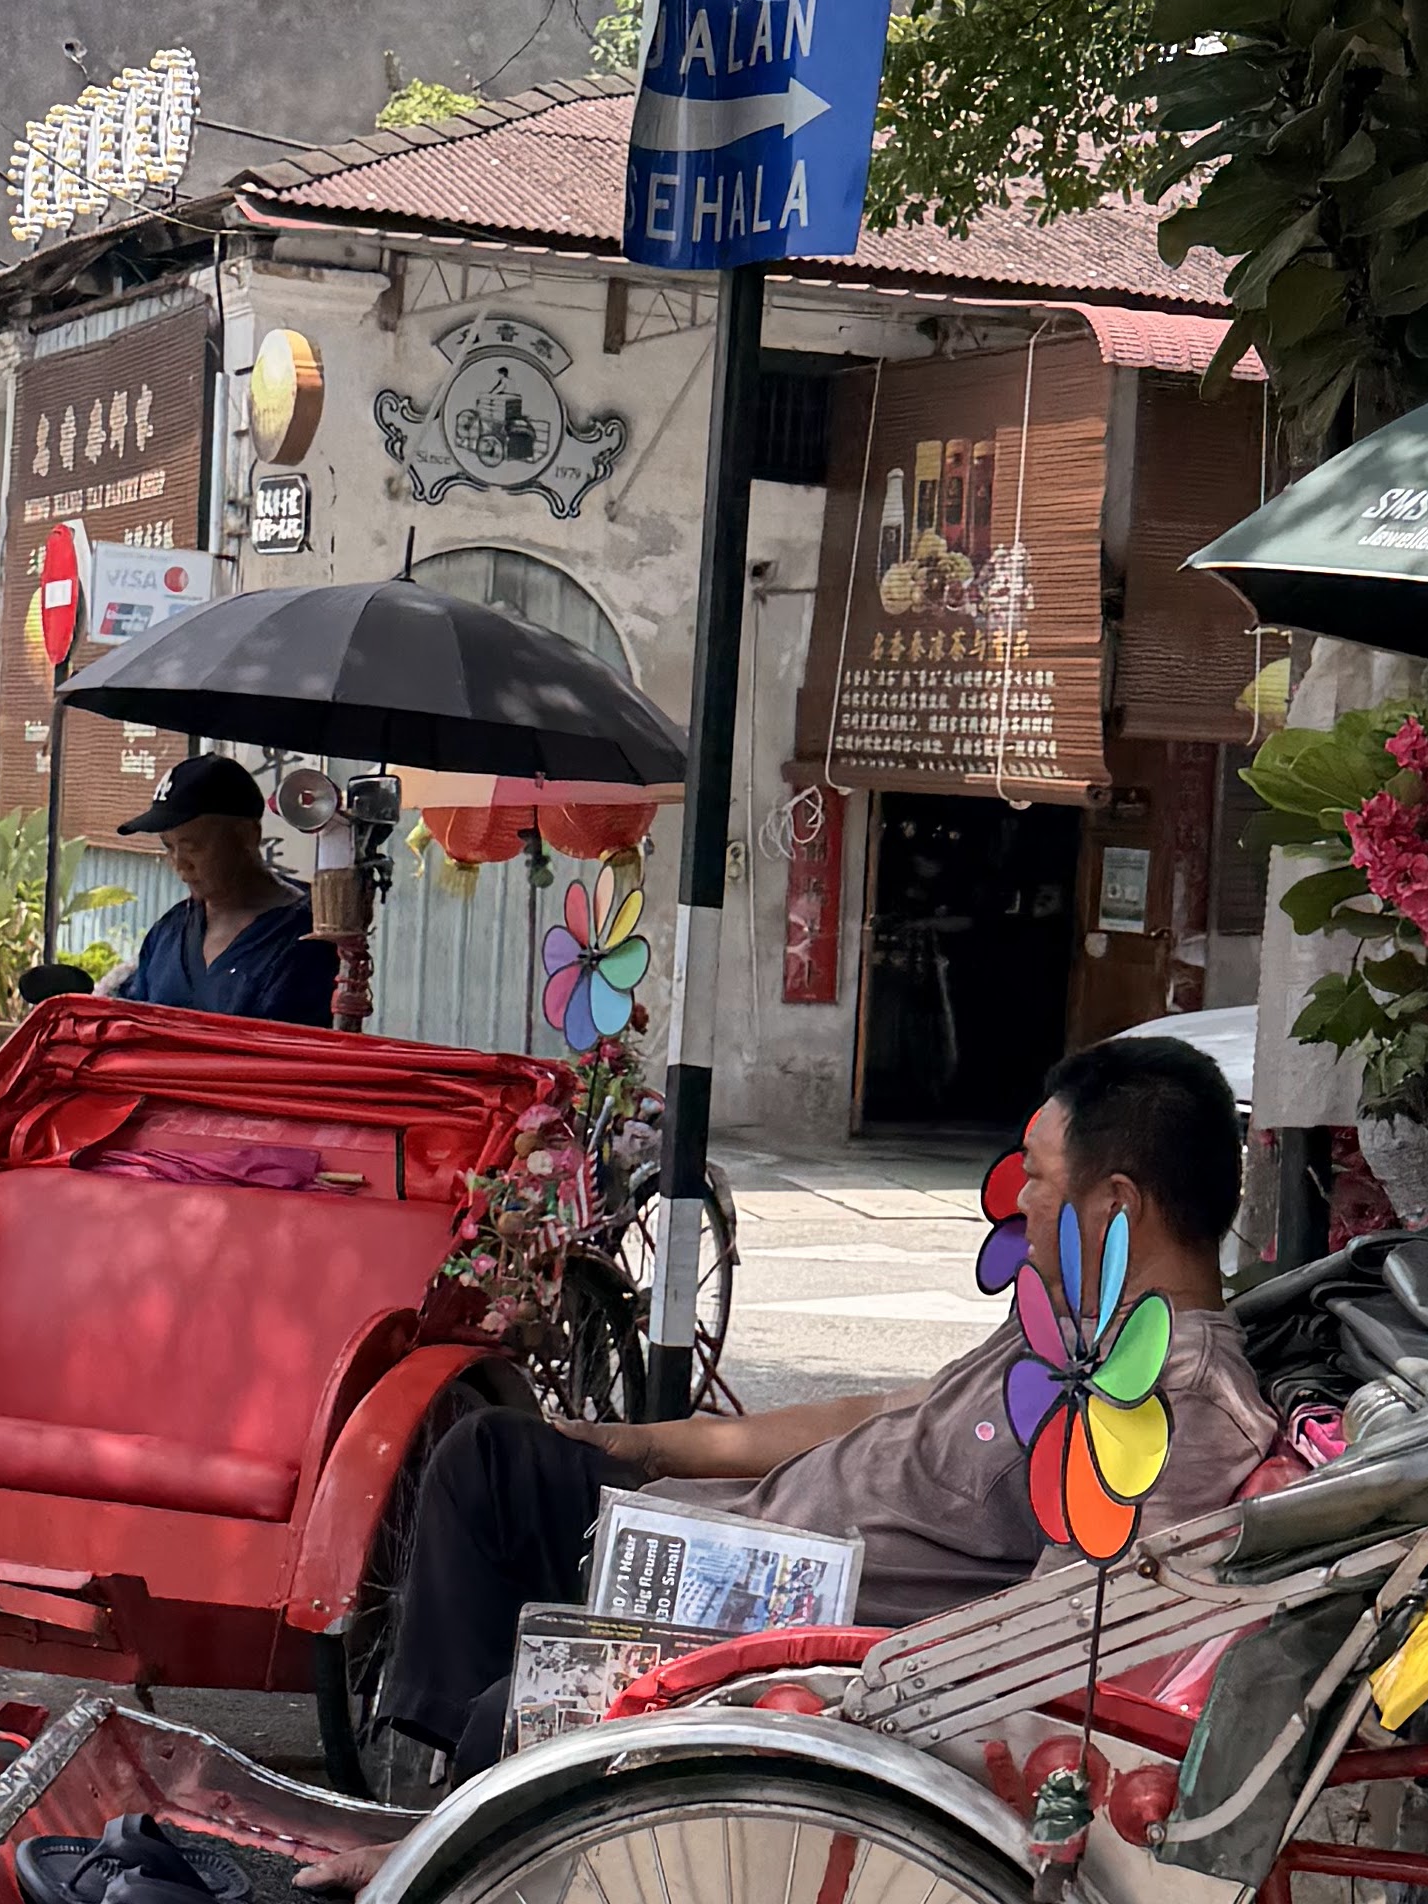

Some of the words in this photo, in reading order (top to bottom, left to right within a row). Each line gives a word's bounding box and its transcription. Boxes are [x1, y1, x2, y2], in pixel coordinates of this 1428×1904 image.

[106, 567, 158, 591] VISA
[619, 1534, 636, 1573] Hour
[638, 1538, 659, 1588] Round
[661, 1543, 681, 1587] Small
[633, 1589, 652, 1615] Big
